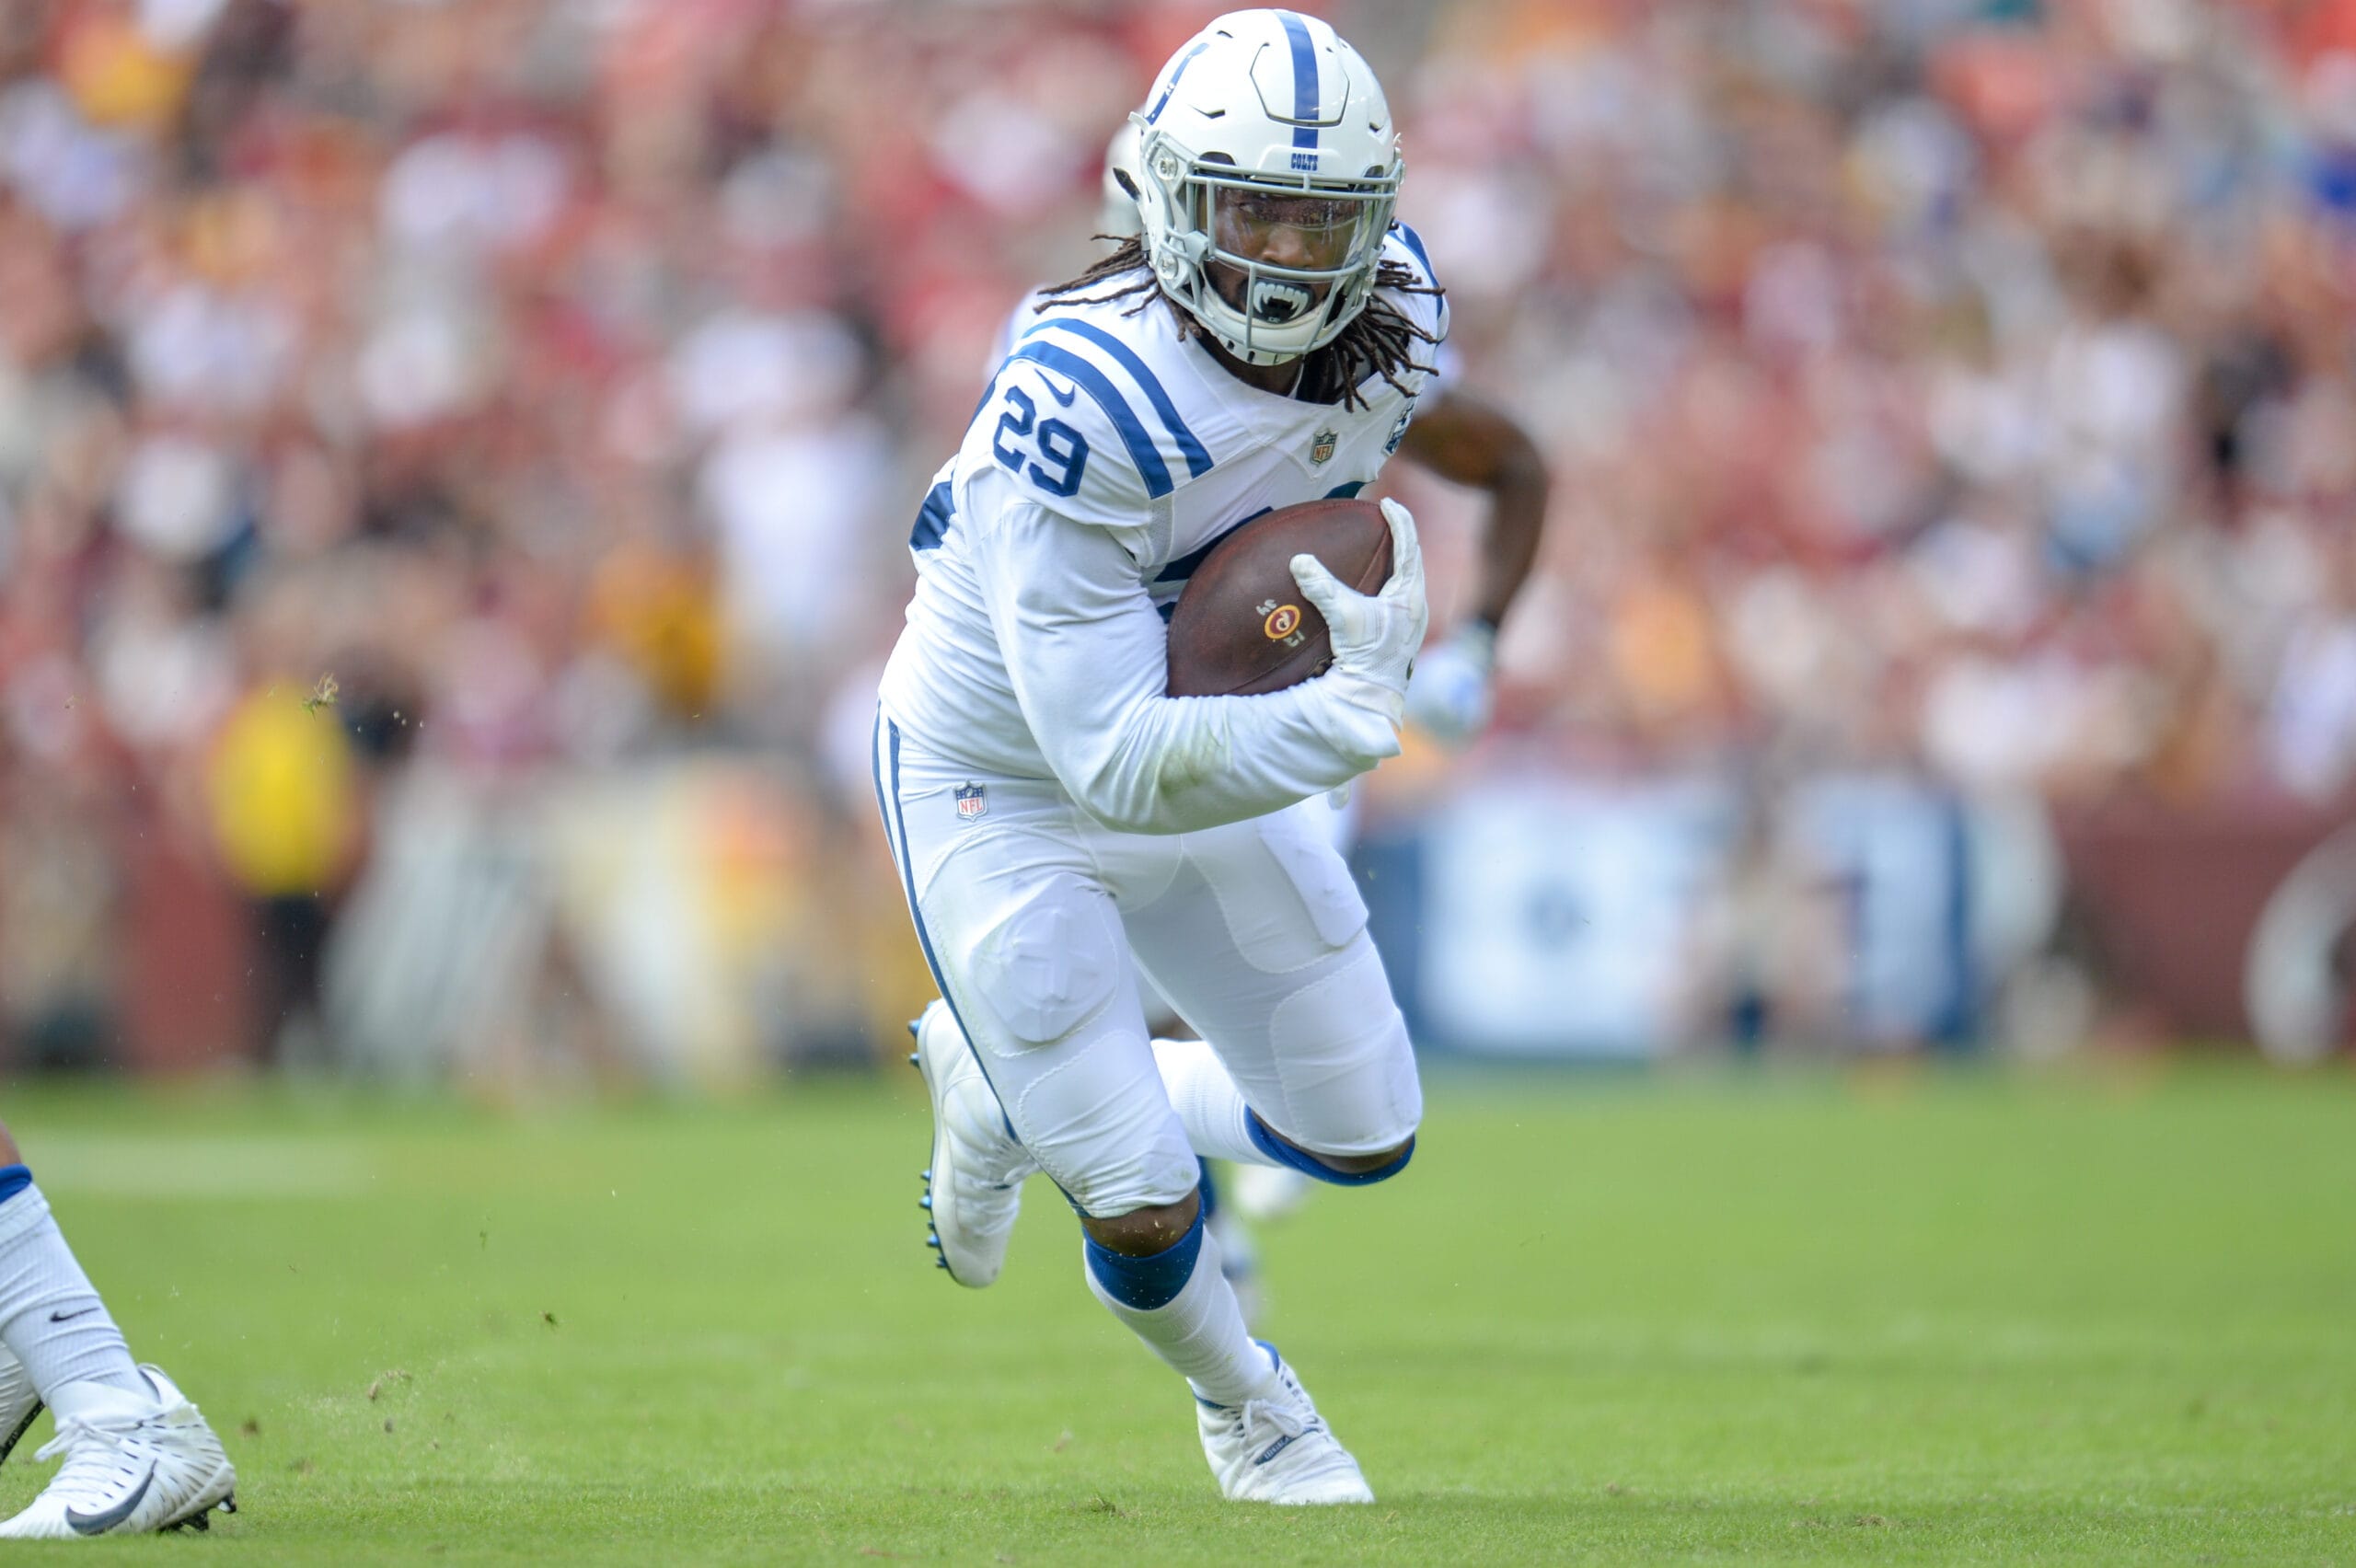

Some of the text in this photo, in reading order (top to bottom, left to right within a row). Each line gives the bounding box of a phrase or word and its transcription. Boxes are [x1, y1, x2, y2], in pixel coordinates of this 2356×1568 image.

[1290, 153, 1318, 171] COLTS
[993, 385, 1090, 498] 29
[959, 798, 983, 814] NFL
